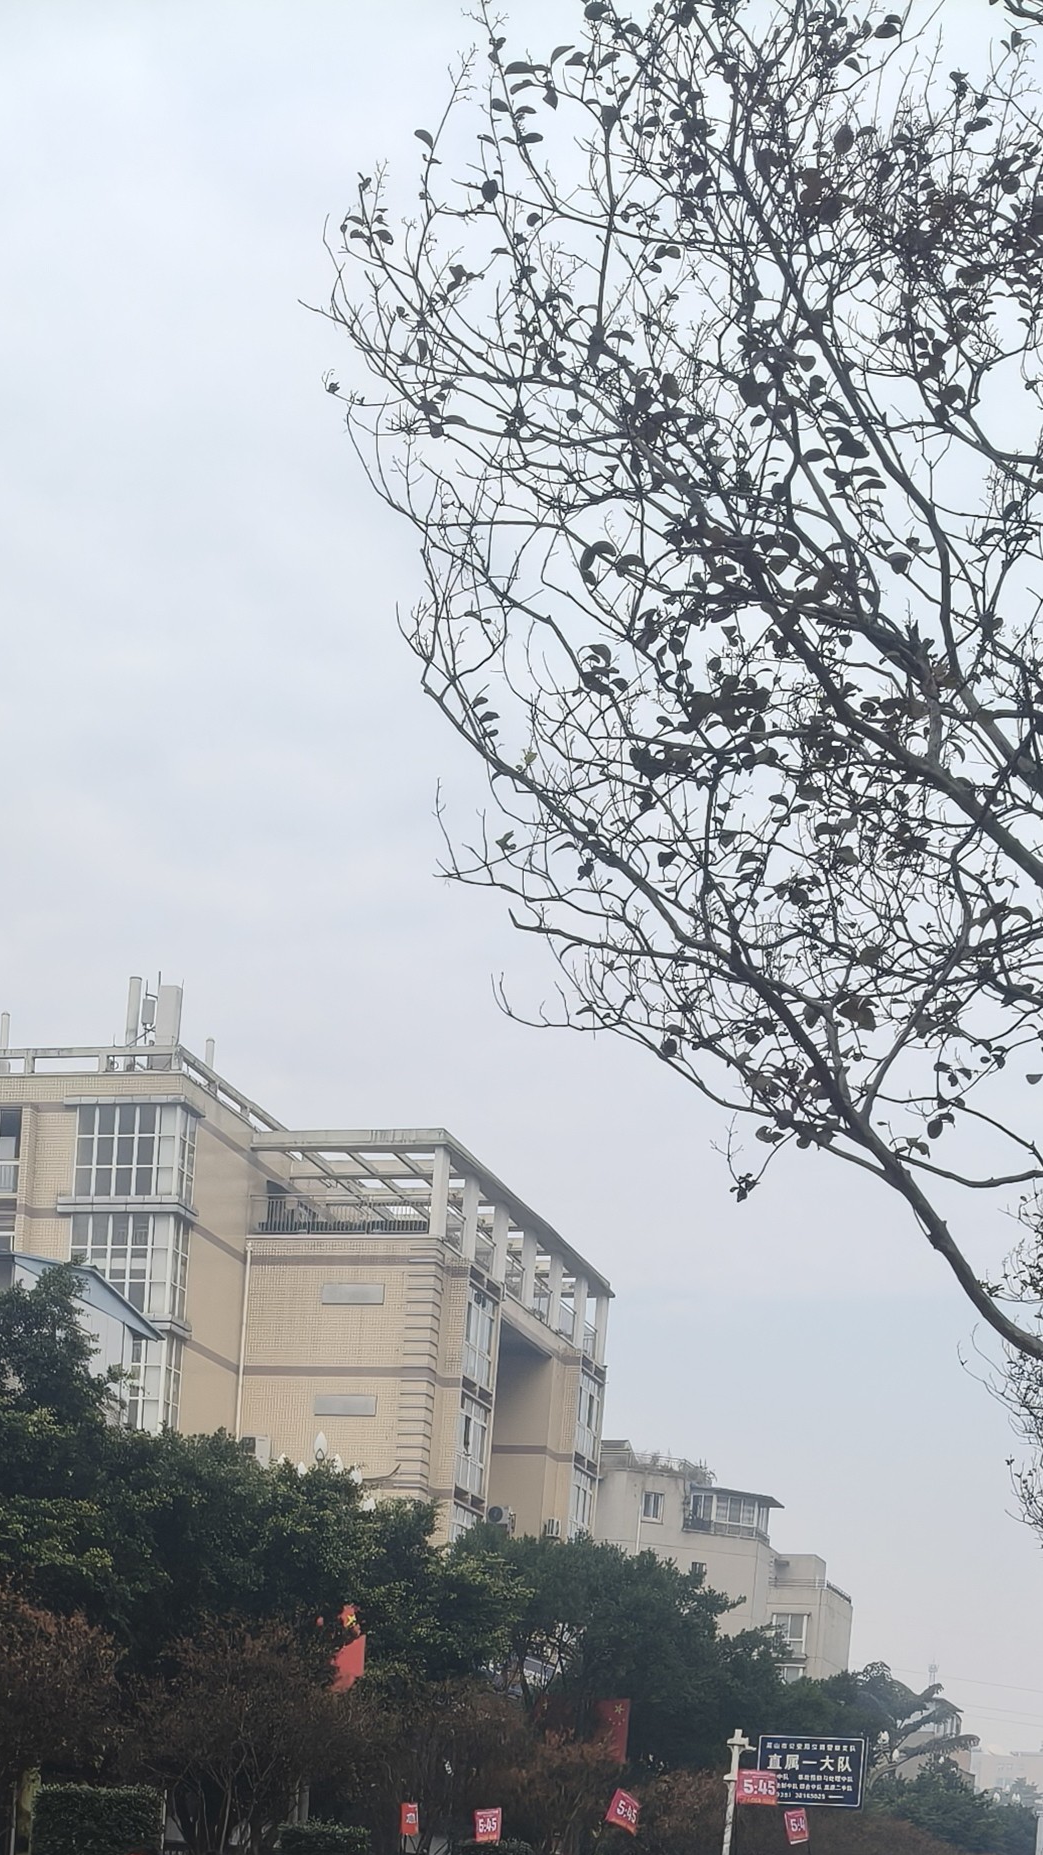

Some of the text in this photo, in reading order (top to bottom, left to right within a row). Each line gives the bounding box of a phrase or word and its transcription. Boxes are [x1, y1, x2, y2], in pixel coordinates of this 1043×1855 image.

[767, 1753, 852, 1772] 直属一大队
[743, 1779, 776, 1795] 5:45
[616, 1800, 637, 1823] 5:45
